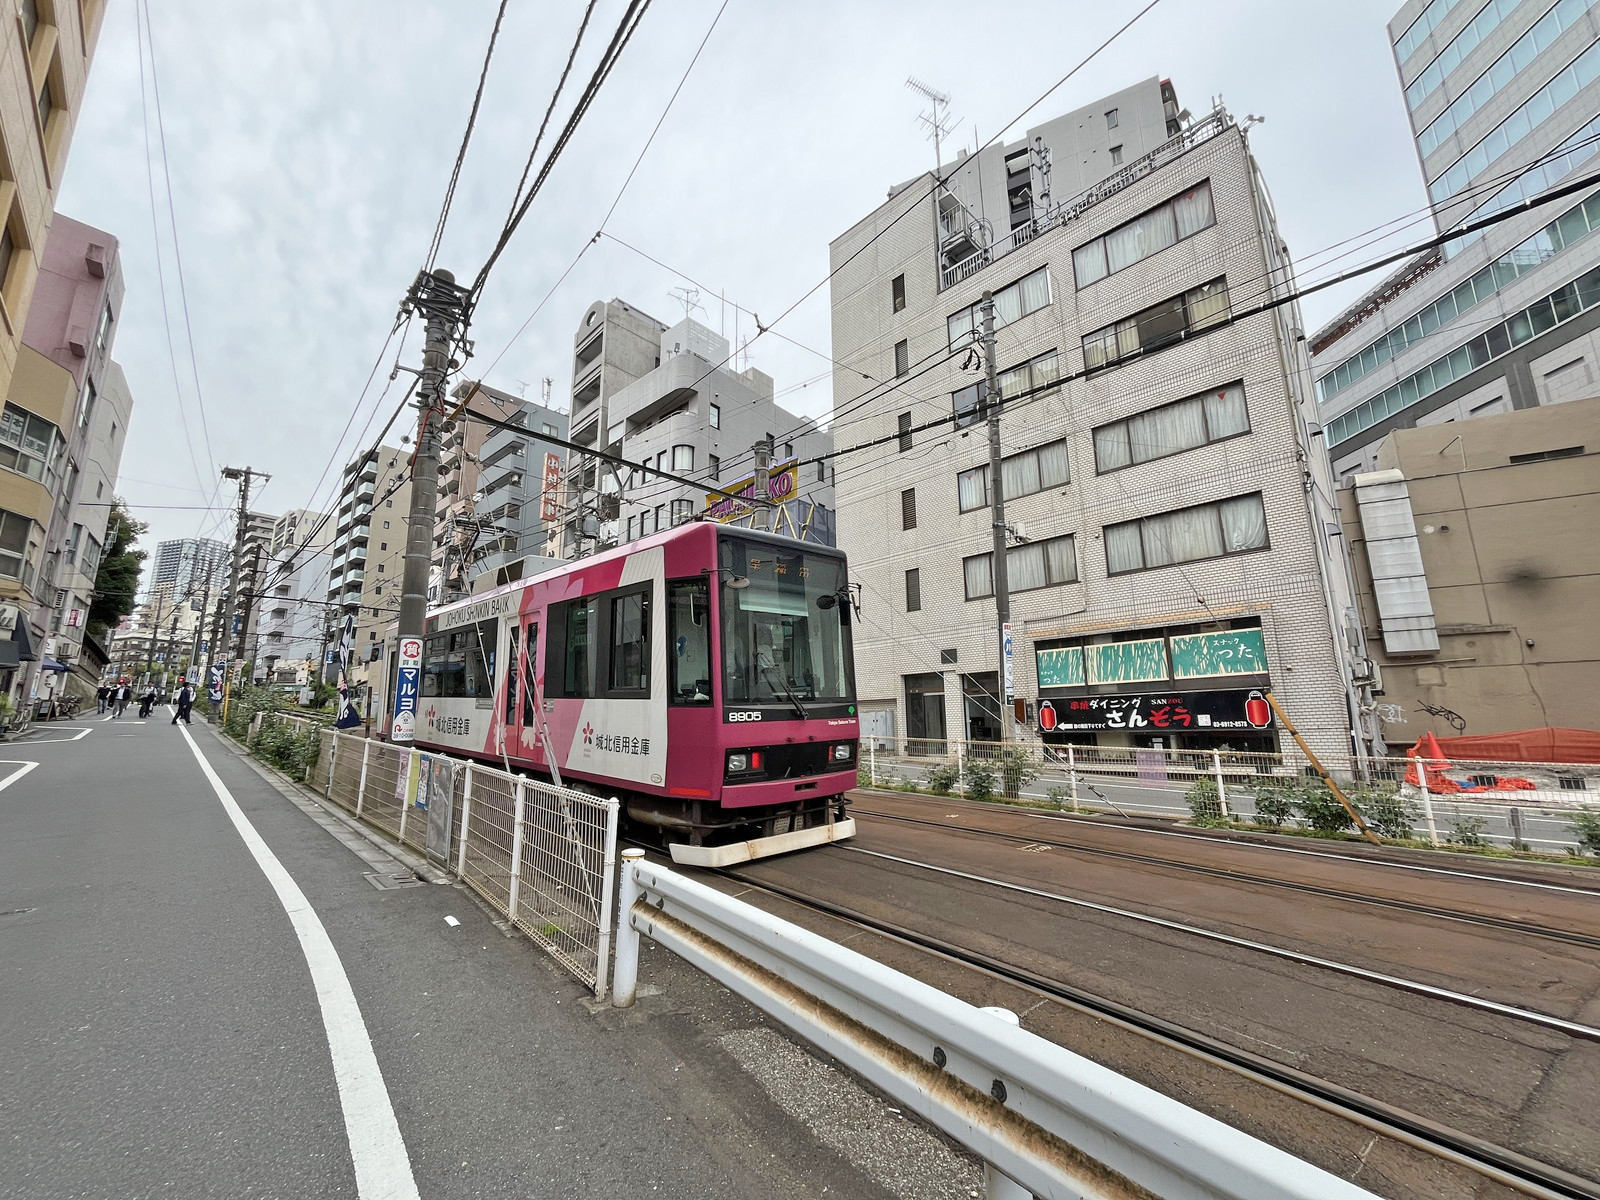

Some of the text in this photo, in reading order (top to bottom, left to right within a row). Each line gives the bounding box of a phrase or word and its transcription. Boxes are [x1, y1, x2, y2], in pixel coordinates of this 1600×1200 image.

[445, 609, 465, 627] JOHOKU
[1213, 637, 1240, 646] スナック
[1218, 643, 1254, 659] つた
[400, 668, 417, 710] マルヨ
[728, 711, 762, 722] 8905
[1105, 706, 1192, 728] さんぞう
[595, 733, 651, 757] 城北信用金庫
